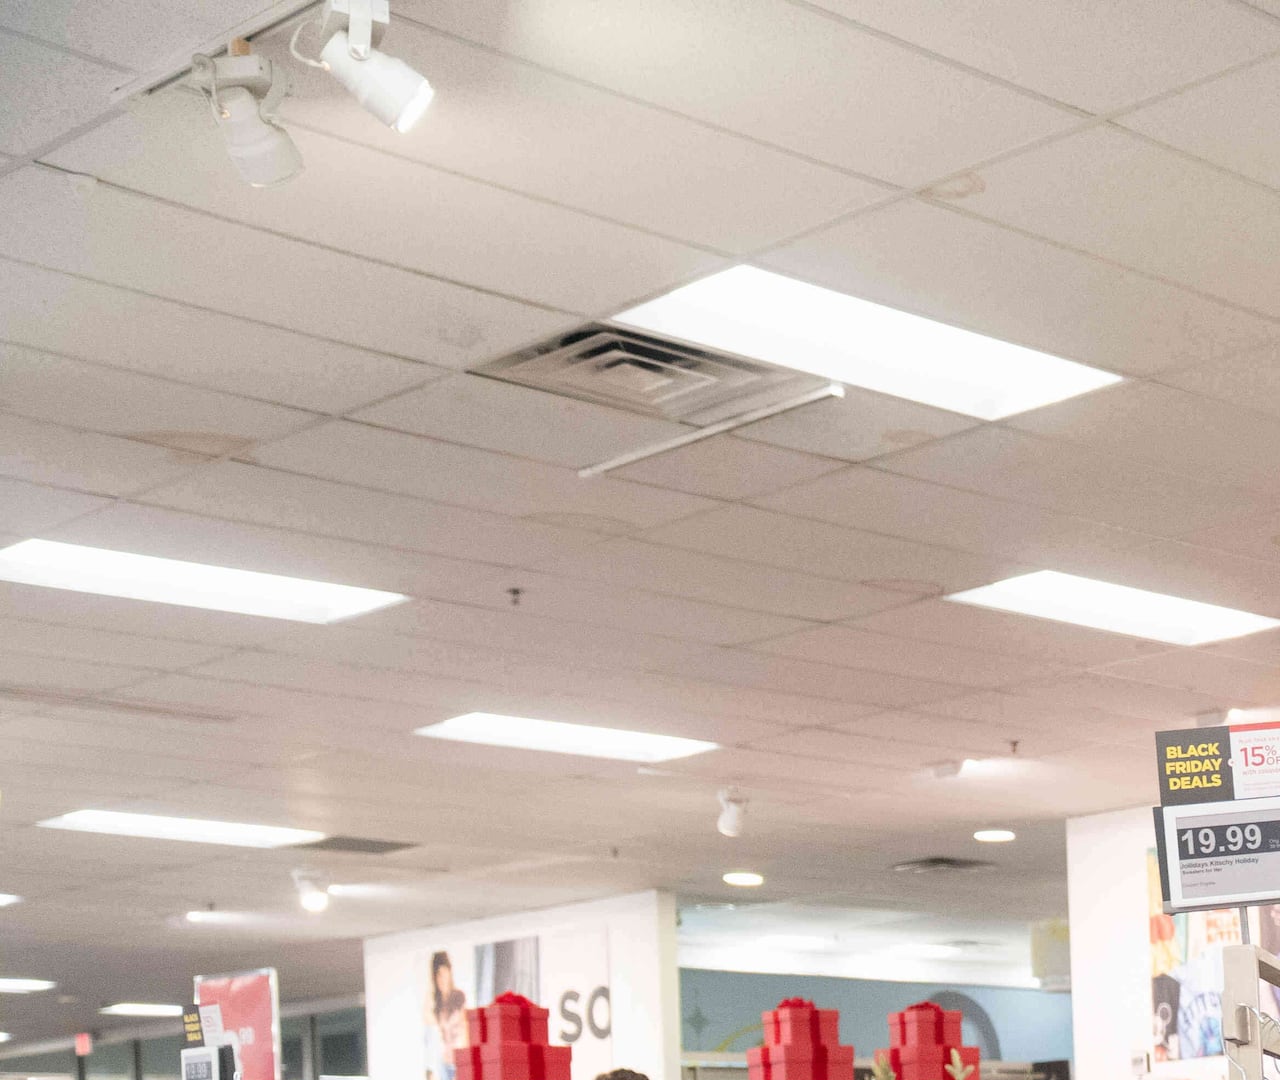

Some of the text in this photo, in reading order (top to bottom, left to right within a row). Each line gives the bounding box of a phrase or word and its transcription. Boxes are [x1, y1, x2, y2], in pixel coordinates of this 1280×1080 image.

[1166, 743, 1220, 759] BLACK
[1240, 746, 1265, 768] 15
[1265, 745, 1277, 756] %
[1165, 758, 1222, 775] FRIDAY
[1169, 774, 1222, 790] DEALS
[1181, 824, 1262, 855] 19.99
